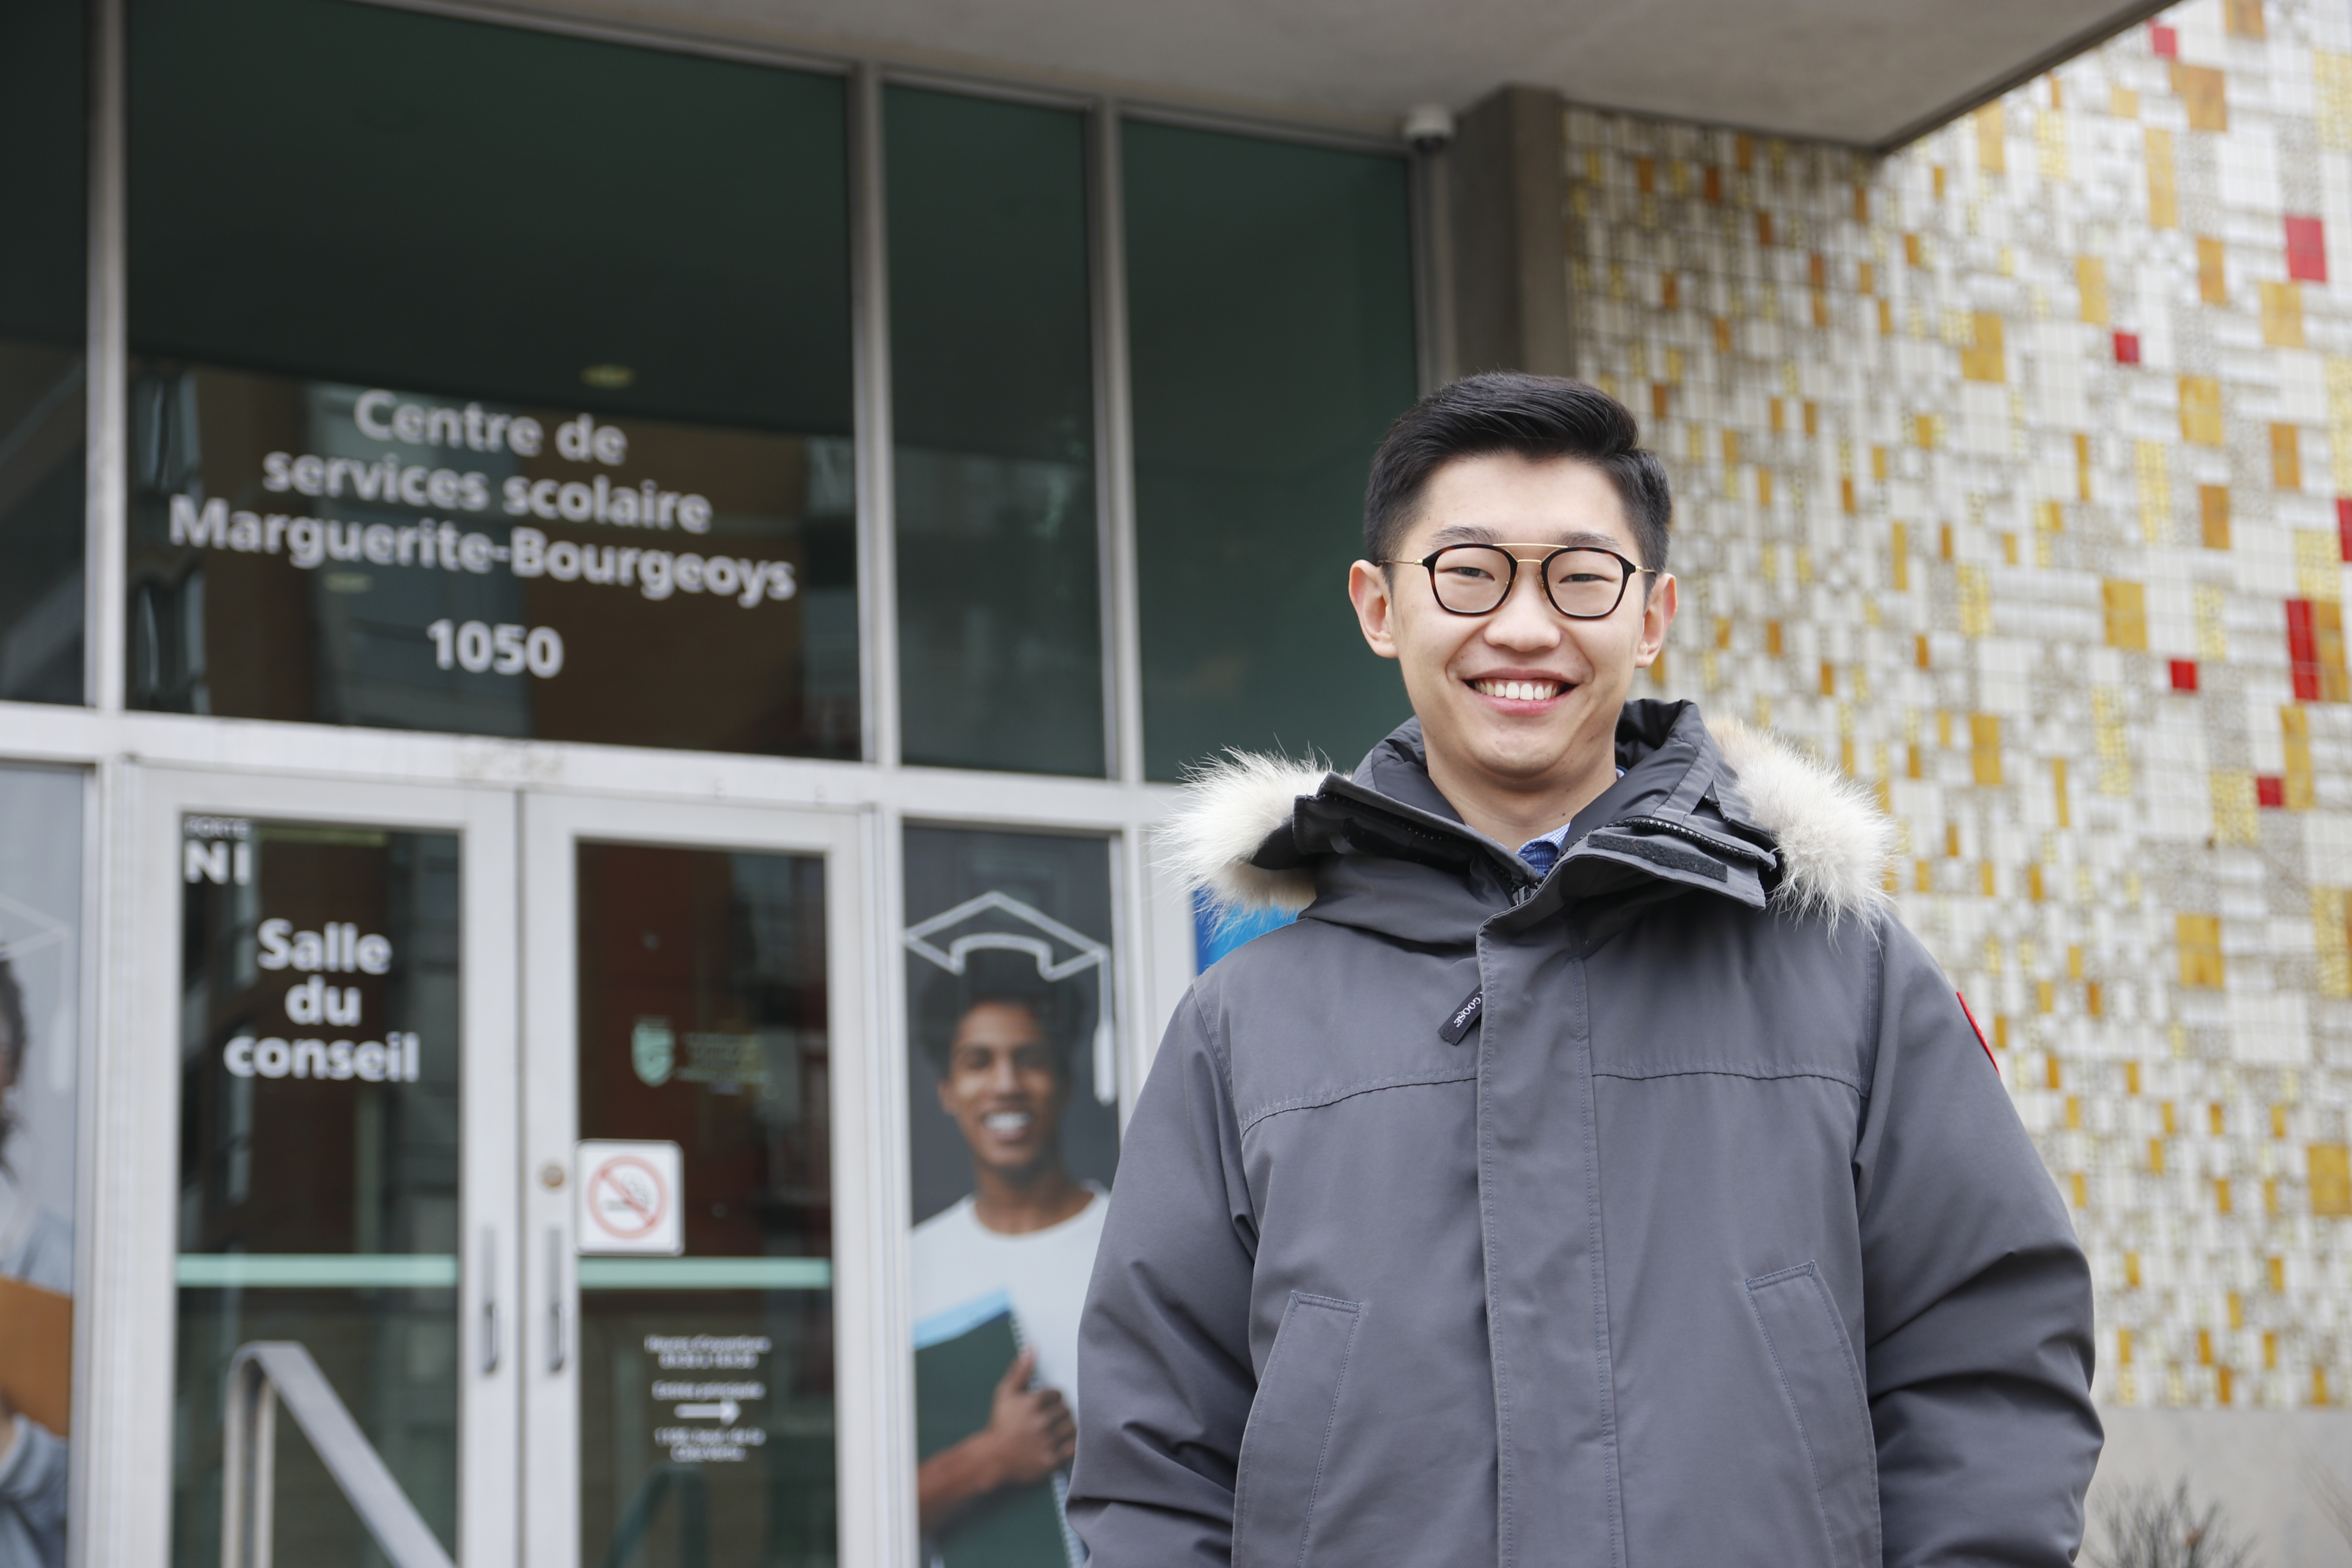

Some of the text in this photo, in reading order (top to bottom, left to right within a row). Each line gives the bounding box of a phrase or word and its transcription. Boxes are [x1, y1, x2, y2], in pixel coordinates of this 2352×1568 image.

[355, 390, 625, 464] Centre de
[266, 453, 711, 532] services scolaire
[171, 495, 794, 606] Marguerite-Bourgeoys
[429, 619, 563, 677] 1050
[258, 919, 391, 974] Salle
[286, 976, 361, 1025] du
[1453, 997, 1481, 1028] GOOSE
[224, 1033, 419, 1082] conseil
